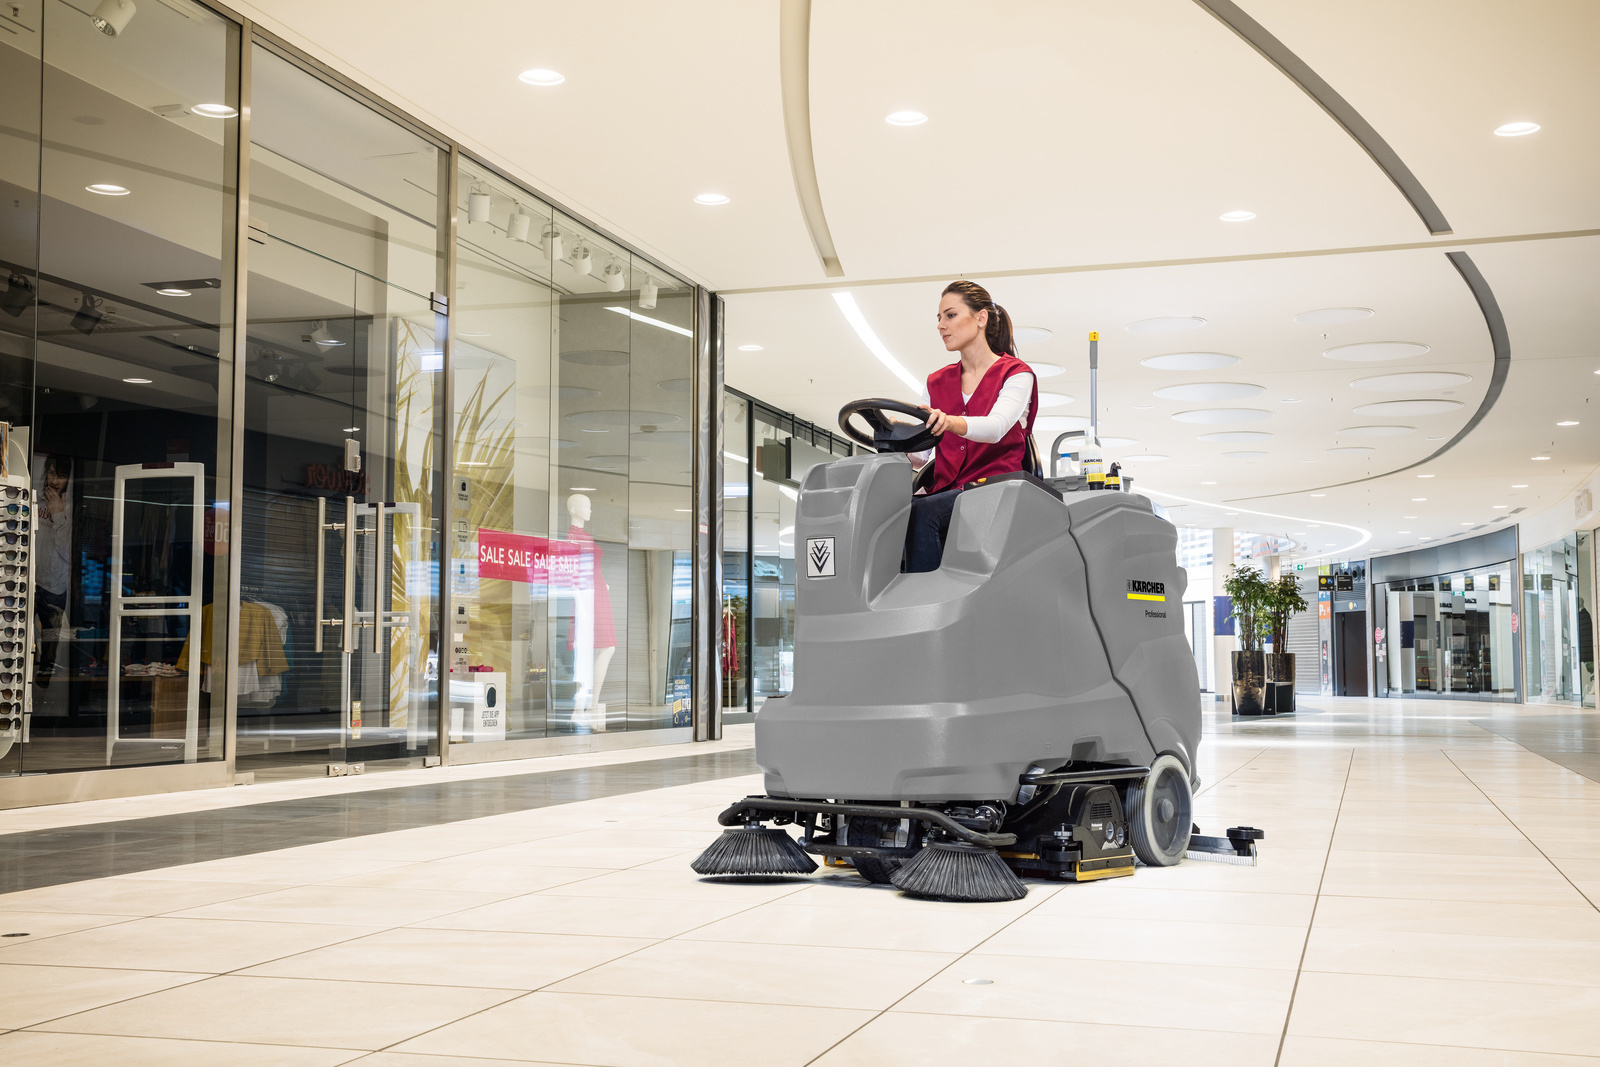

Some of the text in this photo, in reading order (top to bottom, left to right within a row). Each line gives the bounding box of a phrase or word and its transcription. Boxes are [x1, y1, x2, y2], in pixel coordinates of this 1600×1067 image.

[480, 545, 579, 574] SALE SALE SALE SALE
[1132, 580, 1165, 594] KÄRCHER
[1145, 610, 1166, 618] Professional
